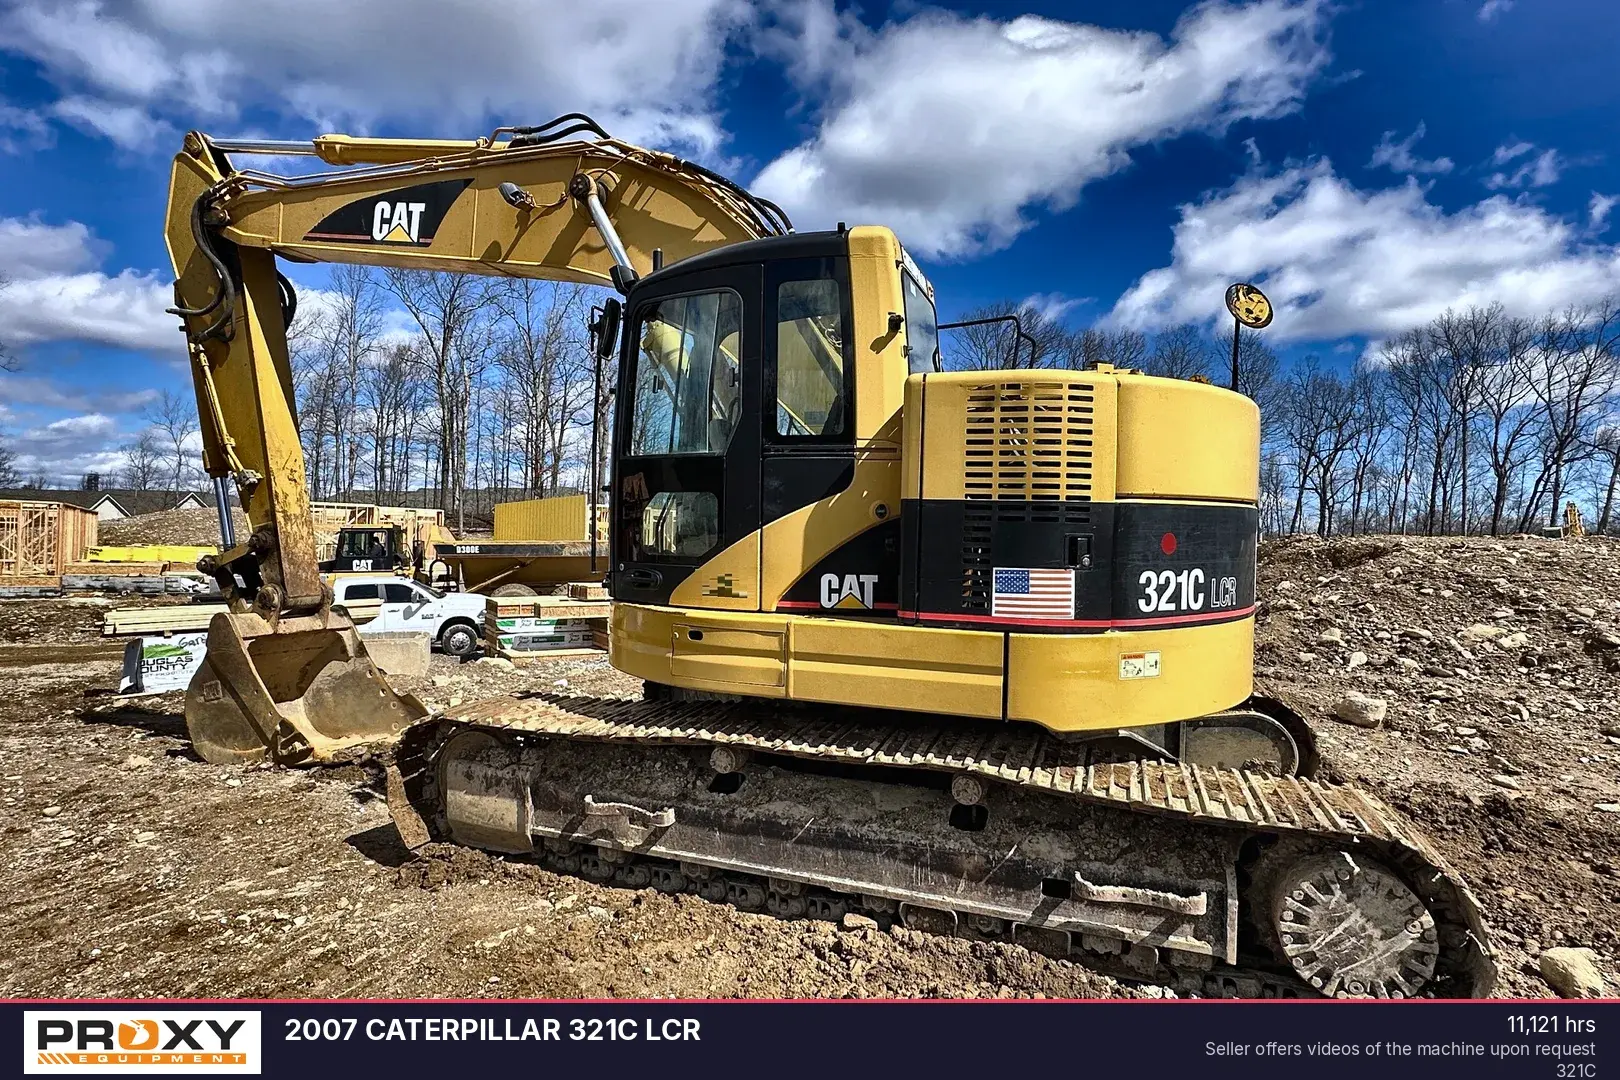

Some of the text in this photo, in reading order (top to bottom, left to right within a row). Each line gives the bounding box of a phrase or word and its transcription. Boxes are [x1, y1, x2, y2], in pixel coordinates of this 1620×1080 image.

[372, 201, 426, 243] CAT
[456, 545, 480, 554] D300E
[352, 559, 374, 572] CAT
[820, 573, 879, 610] CAT
[1138, 568, 1237, 613] 321C LCR
[140, 655, 194, 667] OUGLAS
[141, 662, 188, 674] OUNTY
